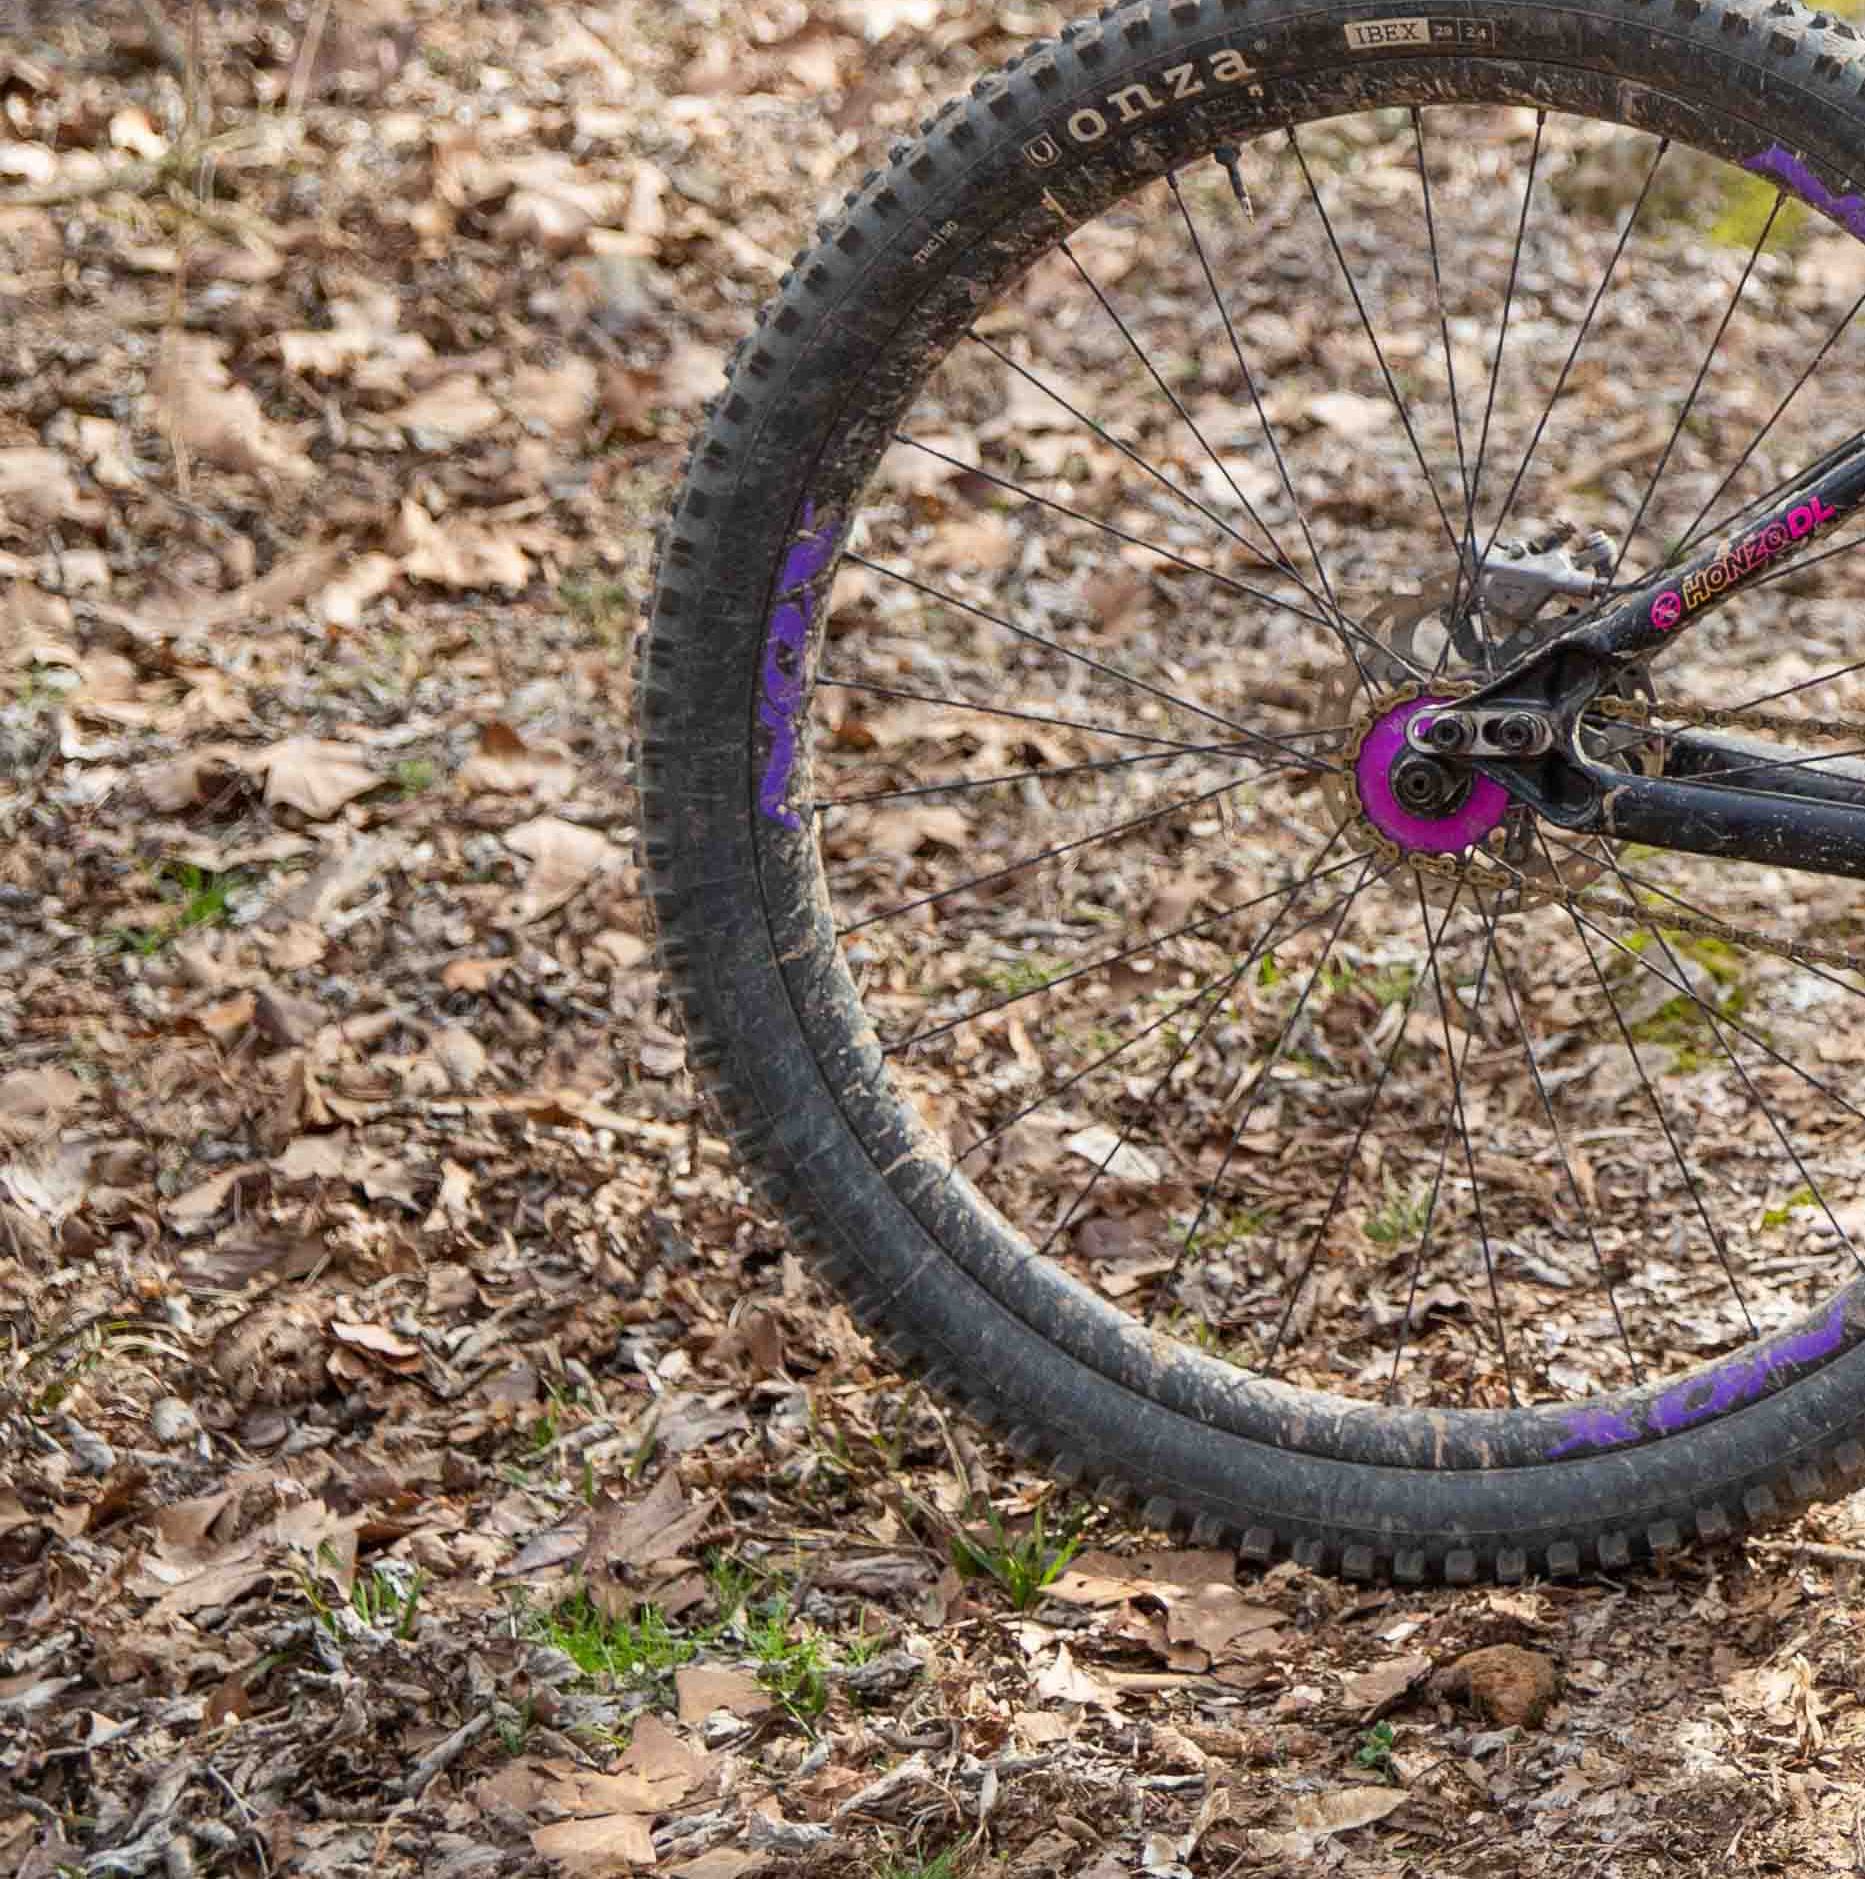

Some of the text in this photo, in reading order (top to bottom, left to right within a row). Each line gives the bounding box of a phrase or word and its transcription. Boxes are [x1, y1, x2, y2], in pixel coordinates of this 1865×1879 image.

[1353, 22, 1421, 46] IBEX
[1067, 48, 1257, 143] onza
[1681, 521, 1788, 610] HONZO
[1786, 496, 1837, 539] DL
